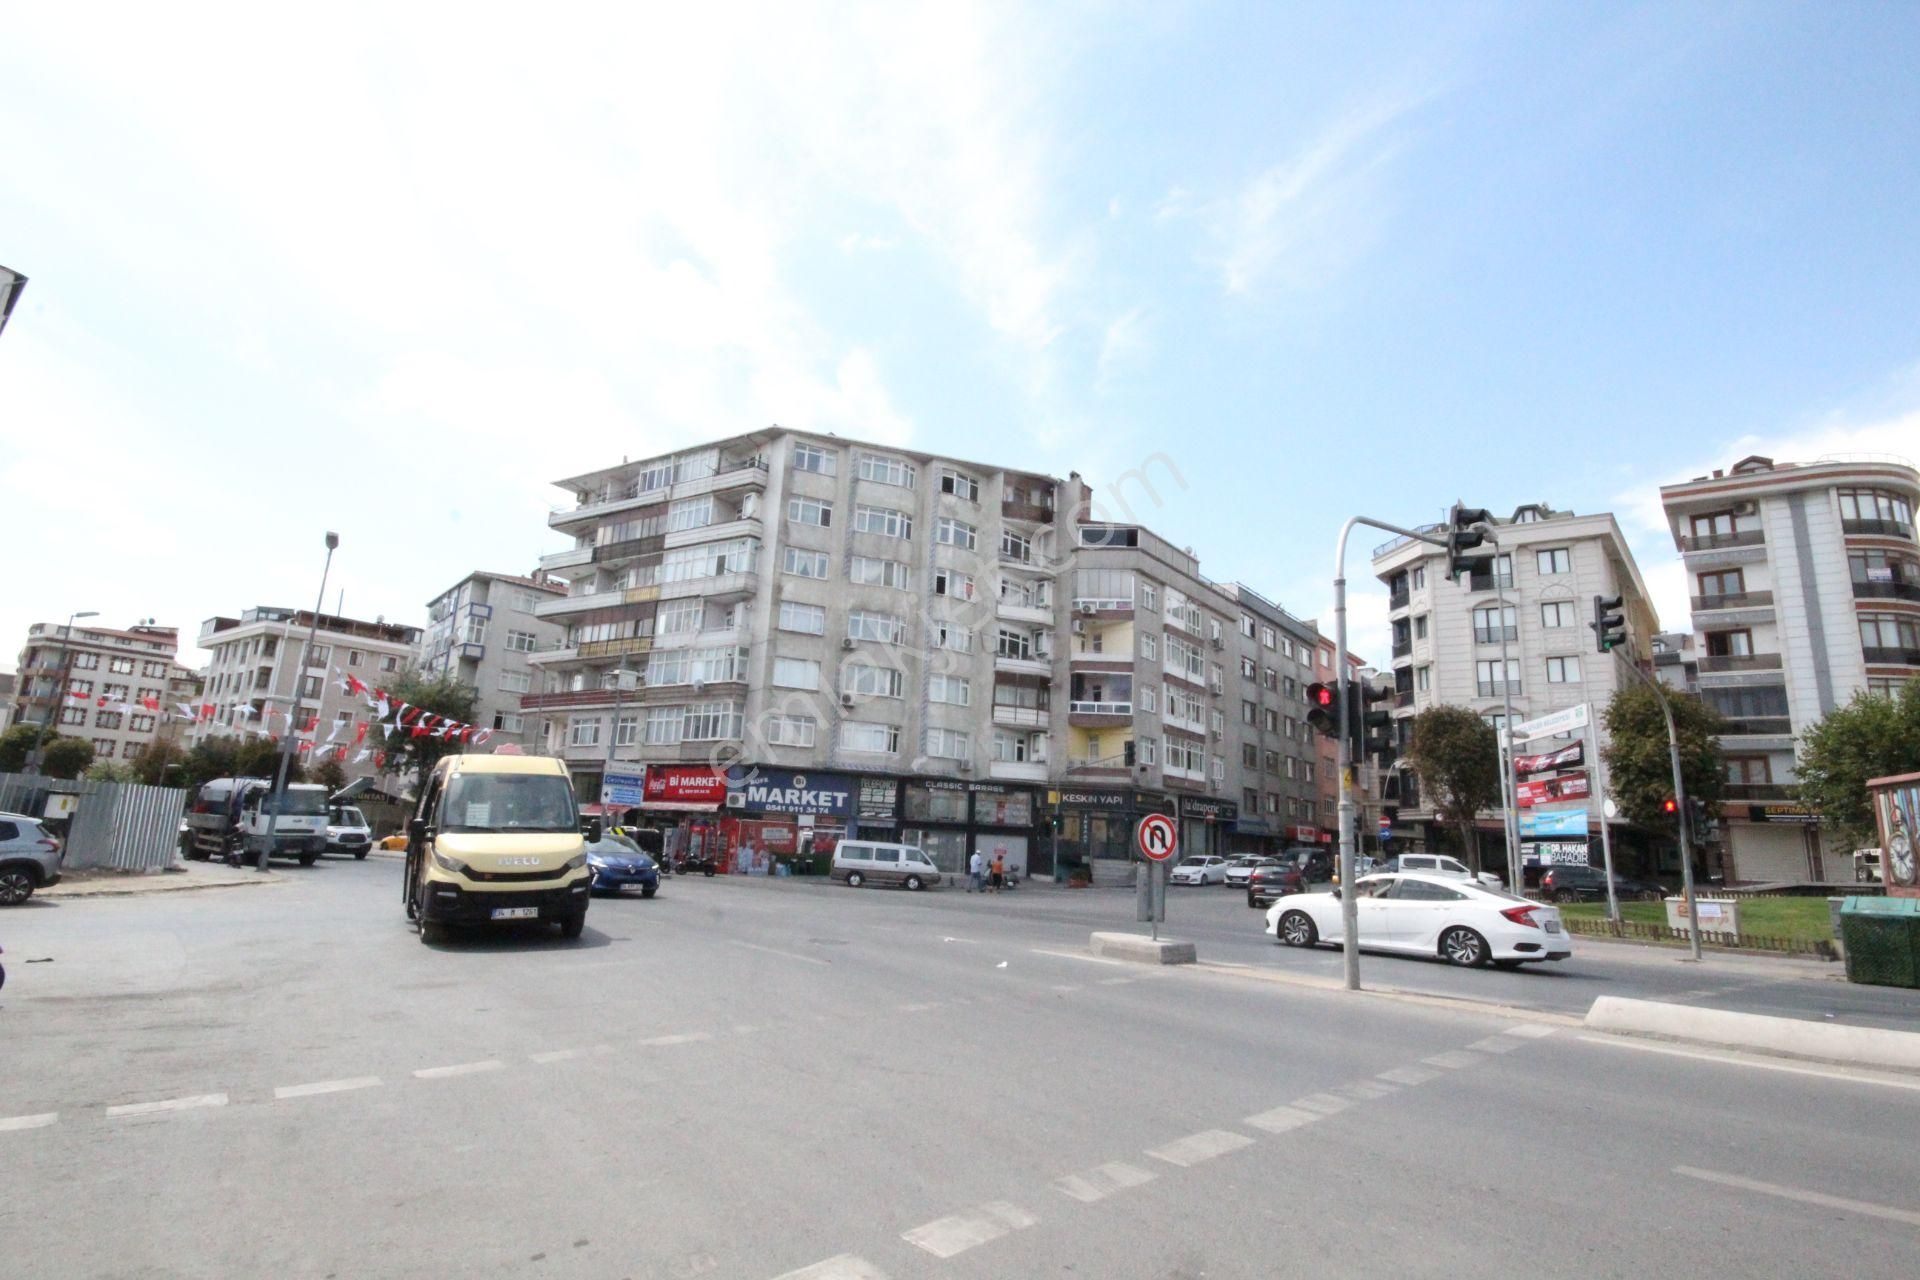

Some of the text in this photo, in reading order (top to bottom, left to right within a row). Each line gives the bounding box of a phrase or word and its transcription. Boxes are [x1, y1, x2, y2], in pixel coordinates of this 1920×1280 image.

[680, 776, 721, 787] MARKET
[925, 780, 963, 790] CLASSIC
[748, 786, 848, 808] MARKET
[1099, 795, 1123, 805] YAPI
[765, 804, 786, 812] 0541
[788, 805, 804, 813] 911
[1562, 843, 1588, 853] HAKAN
